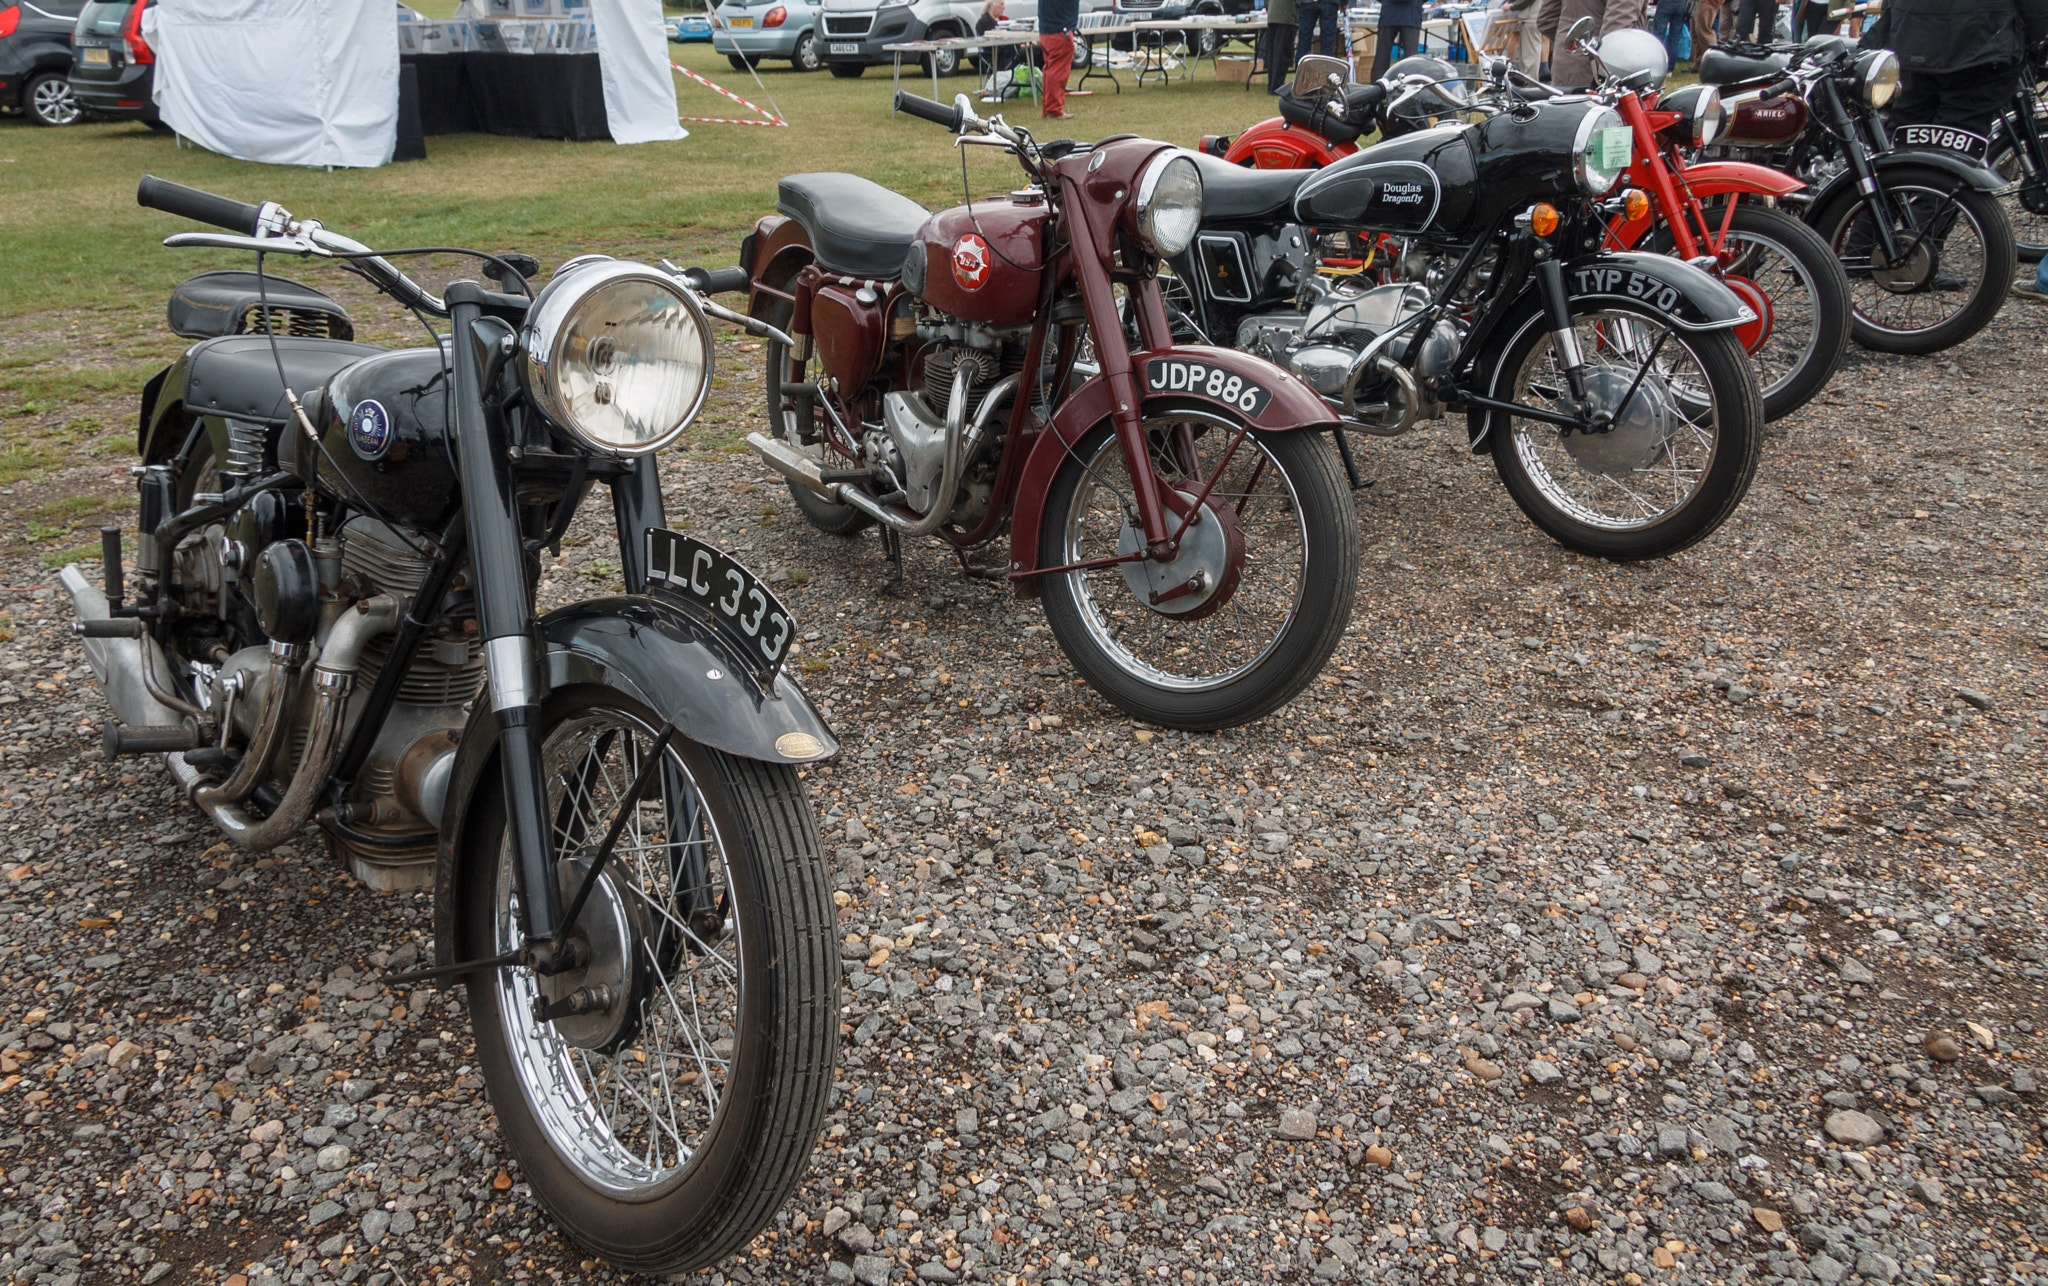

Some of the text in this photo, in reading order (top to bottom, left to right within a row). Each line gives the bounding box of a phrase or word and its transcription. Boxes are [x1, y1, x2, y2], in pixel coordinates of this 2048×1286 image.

[1757, 110, 1783, 118] ARIEL
[1906, 128, 1974, 152] ESV881
[1383, 182, 1422, 195] Douglas
[1382, 193, 1424, 205] Dragonfly
[960, 253, 979, 268] BSA
[1575, 269, 1677, 311] TYP 570
[1151, 362, 1261, 412] JDP886
[355, 432, 379, 446] SUNBEAM
[647, 533, 789, 661] LLC 333
